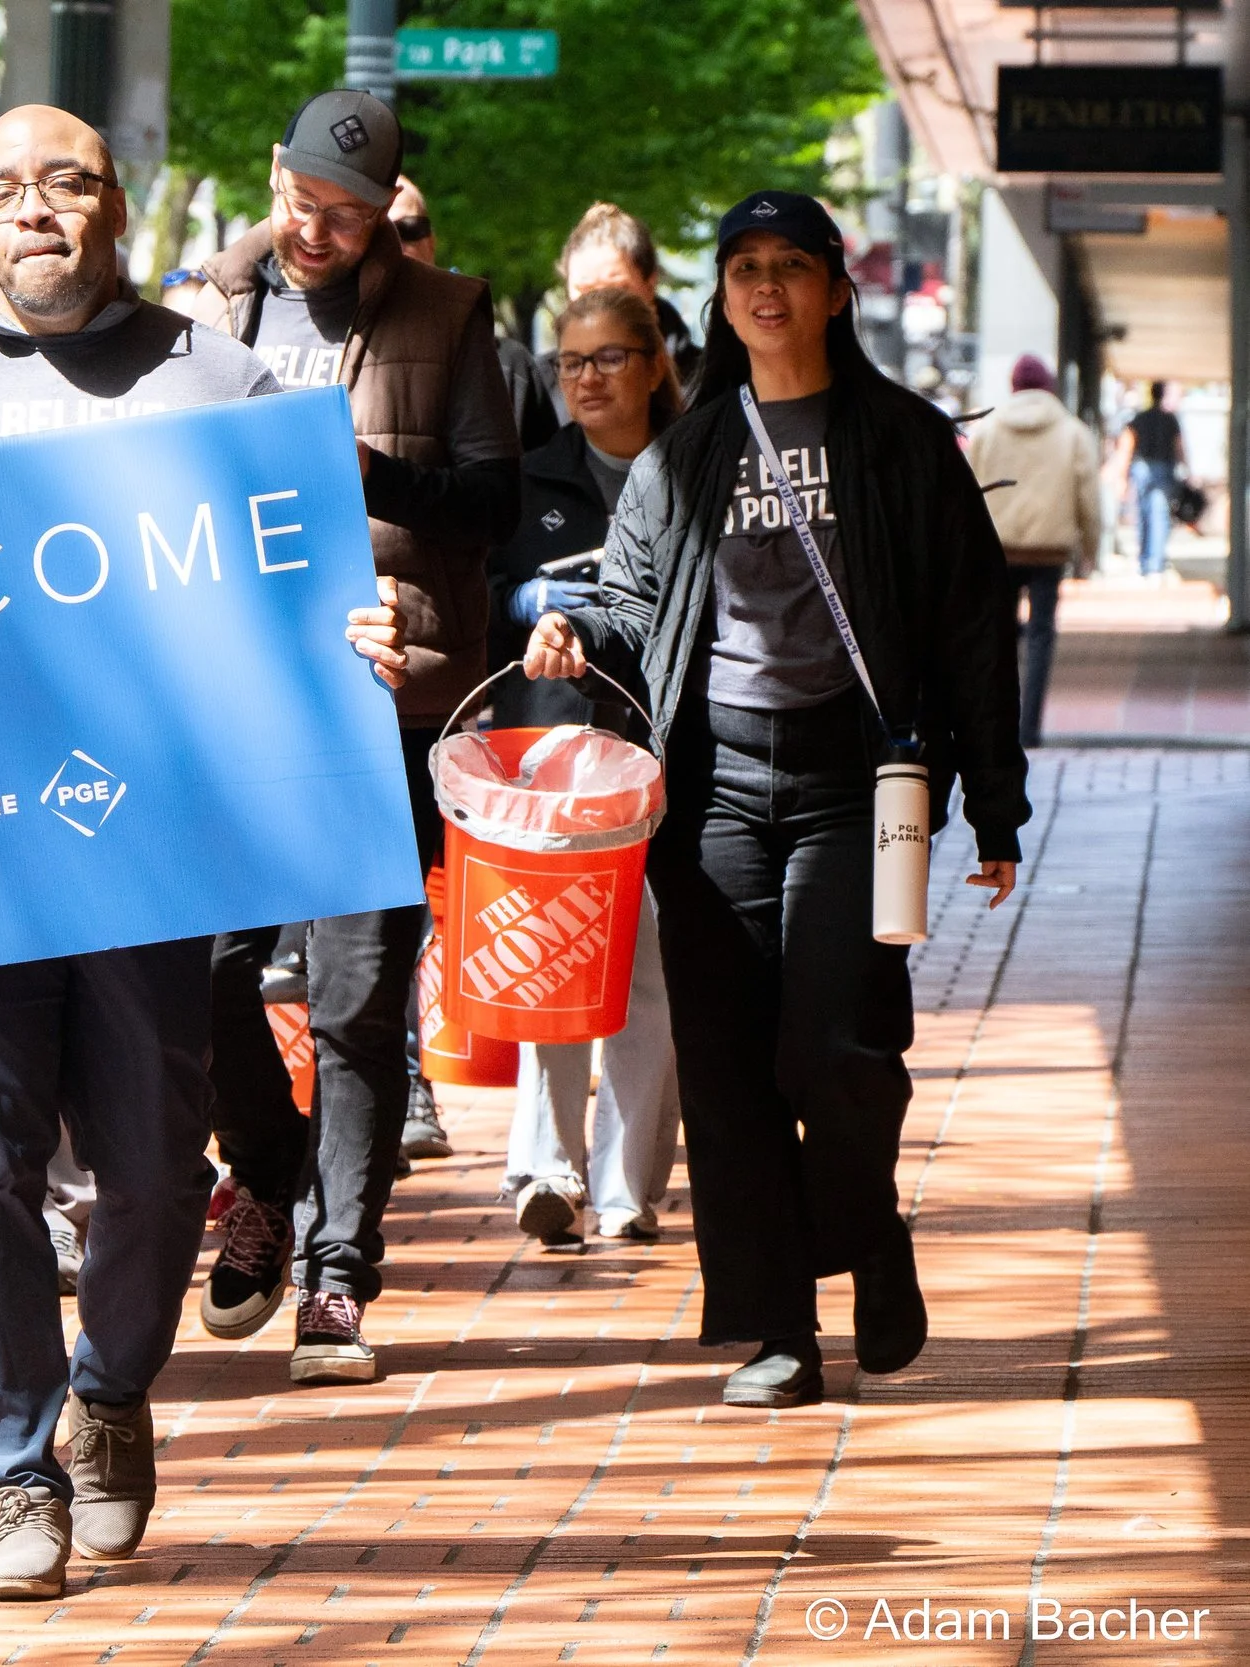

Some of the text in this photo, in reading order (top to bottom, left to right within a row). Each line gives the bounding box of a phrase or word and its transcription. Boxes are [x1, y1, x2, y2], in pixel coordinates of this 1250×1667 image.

[443, 36, 505, 65] Park
[257, 345, 344, 386] ELIE
[2, 399, 165, 436] BELI
[758, 446, 830, 491] BELI
[57, 780, 111, 807] PGE
[891, 833, 925, 844] PARKS
[898, 824, 920, 834] PGE
[475, 885, 541, 935] THE
[462, 874, 613, 1002] HOME
[513, 922, 610, 1009] DEPOT
